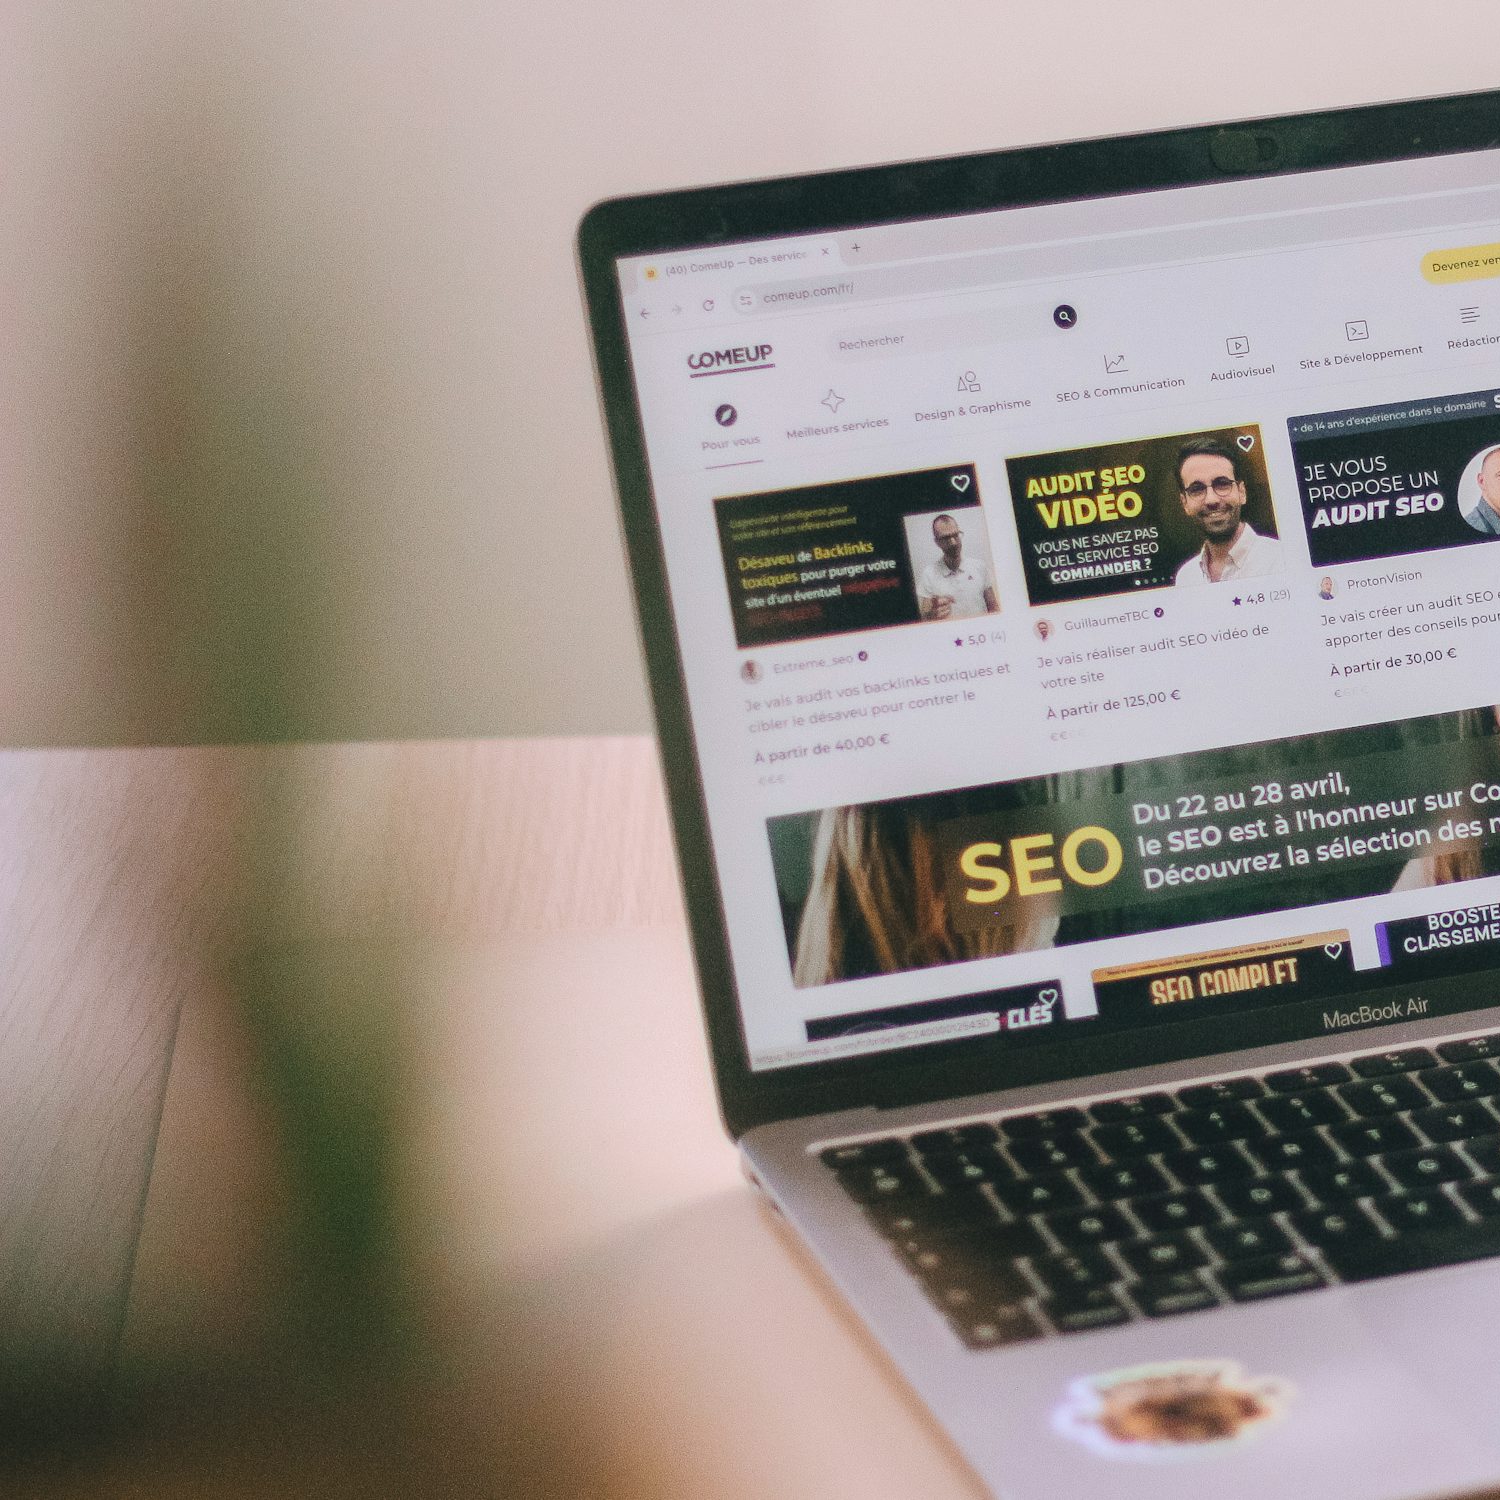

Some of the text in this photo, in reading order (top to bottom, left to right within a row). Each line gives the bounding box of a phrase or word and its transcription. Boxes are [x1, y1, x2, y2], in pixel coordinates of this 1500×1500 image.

[1432, 259, 1480, 273] Devenez
[763, 282, 855, 304] comeup.com/fr/
[687, 344, 773, 370] COMEUP
[839, 335, 905, 351] Rechercher
[1299, 345, 1424, 370] Site Développement
[1210, 365, 1275, 382] Audiovisuel
[1056, 377, 1185, 403] SEO Communication
[915, 398, 1032, 423] Design Graphisme
[1300, 398, 1486, 433] de 14 ans d'expérience dans le domaine
[701, 436, 761, 451] Pour vous
[786, 418, 889, 440] Meilleurs services
[1026, 464, 1146, 499] AUDIT SEO
[1304, 456, 1387, 482] JE VOUS
[1308, 470, 1440, 503] PROPOSE UN
[1037, 487, 1143, 529] VIDÉO
[1311, 492, 1444, 529] AUDIT SEO
[1033, 526, 1159, 555] VOUS NE SAVEZ PAS
[1038, 541, 1159, 569] QUEL SERVICE SEO
[738, 541, 875, 571] Désaveu de Backlinks
[741, 558, 897, 590] toxiques pour purger votre
[1050, 560, 1141, 583] COMMANDER
[1347, 571, 1423, 590] ProtonVision
[1064, 609, 1149, 632] GuillaumeTBC
[1321, 615, 1336, 626] Je
[1340, 609, 1366, 623] vais
[1369, 604, 1402, 619] créer
[1407, 601, 1424, 613] un
[1428, 595, 1463, 610] audit
[1466, 590, 1493, 604] SEO
[1037, 623, 1270, 669] Je vais réaliser audit SEO vidéo de
[1325, 630, 1383, 649] apporter
[1387, 625, 1411, 638] des
[1415, 616, 1467, 633] conseils
[1344, 647, 1458, 677] partir de 30,00 €
[746, 662, 1010, 712] Je vais audit vos backlinks toxiques et
[1041, 670, 1104, 690] votre site
[748, 690, 975, 733] cibler le désaveu pour contrer le
[1061, 689, 1181, 720] partir de 125,00 €
[769, 743, 831, 764] partir de
[1132, 772, 1350, 825] Du 22 au 28 avril,
[1137, 836, 1161, 858] le
[1167, 825, 1222, 853] SEO
[1229, 818, 1269, 842] est
[1275, 813, 1289, 835] à
[1299, 798, 1416, 832] l'honneur
[1424, 791, 1463, 812] sur
[960, 825, 1123, 904] SEO
[1143, 848, 1281, 890] Découvrez
[1287, 843, 1310, 867] la
[1317, 826, 1432, 862] sélection
[1439, 818, 1483, 843] des
[1008, 1002, 1052, 1029] CLÉS
[1323, 997, 1428, 1028] MacBook Air
